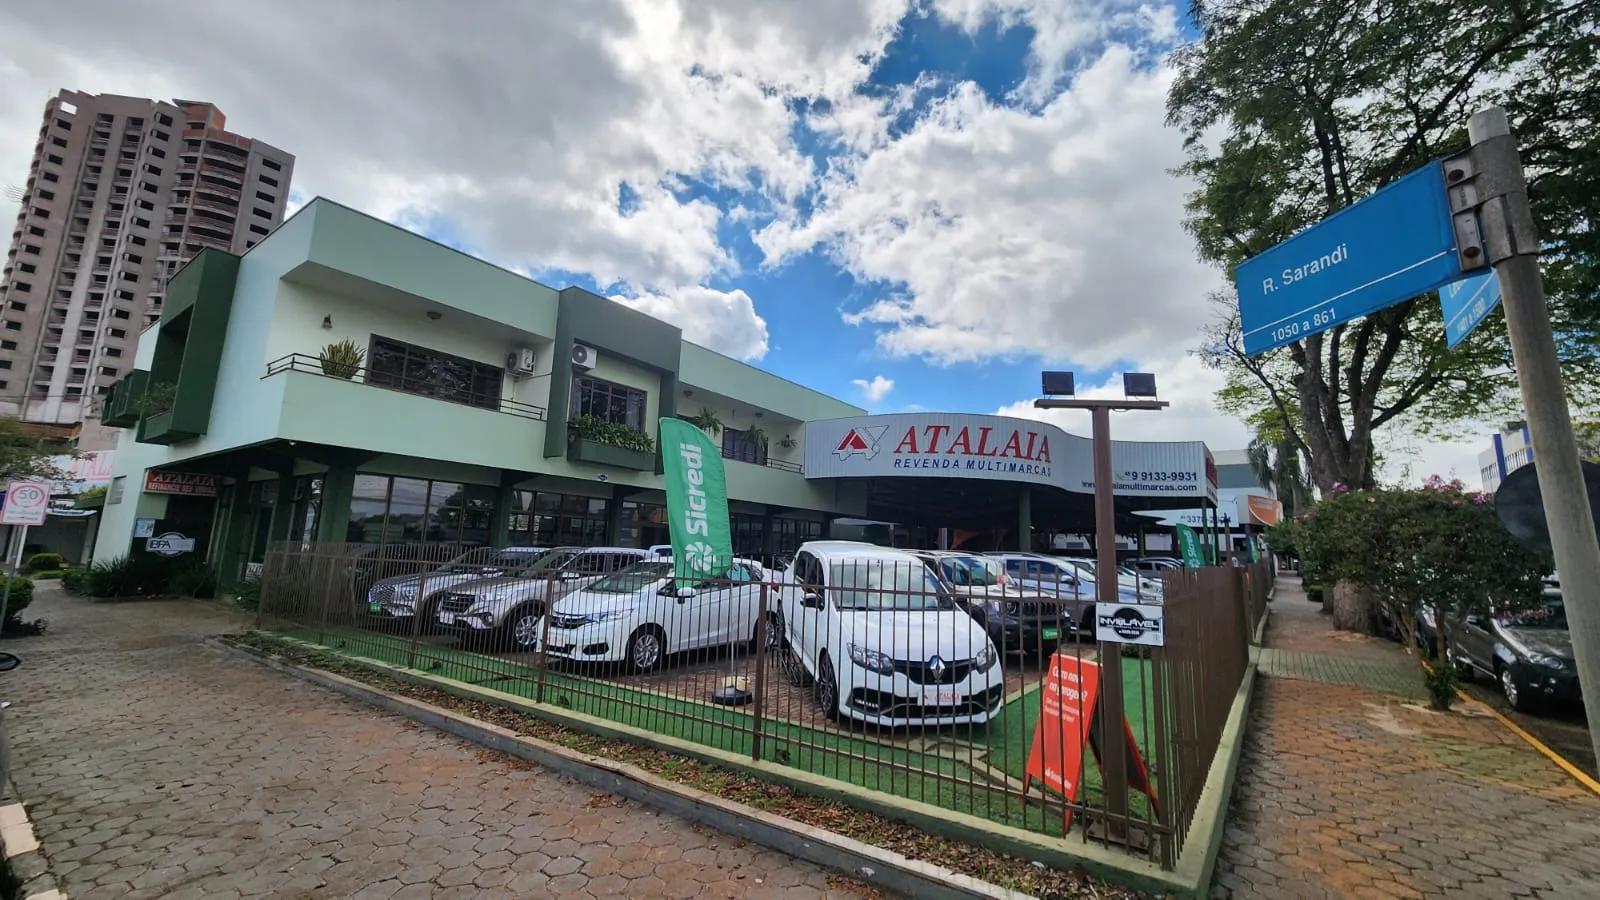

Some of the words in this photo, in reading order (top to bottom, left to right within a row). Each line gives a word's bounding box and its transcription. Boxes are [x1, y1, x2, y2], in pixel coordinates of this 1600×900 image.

[1262, 277, 1278, 296] R.
[1282, 243, 1348, 287] Sarandi
[1271, 323, 1299, 343] 1050
[1302, 320, 1311, 331] a
[1313, 308, 1337, 327] 861
[893, 425, 1052, 463] ATALAIA
[894, 458, 960, 469] REVENDA
[966, 460, 1052, 477] MULTIMARCAS
[1132, 472, 1138, 480] 9
[1141, 472, 1198, 481] 9133-9931
[19, 489, 38, 500] 50
[680, 442, 708, 537] Sicredi
